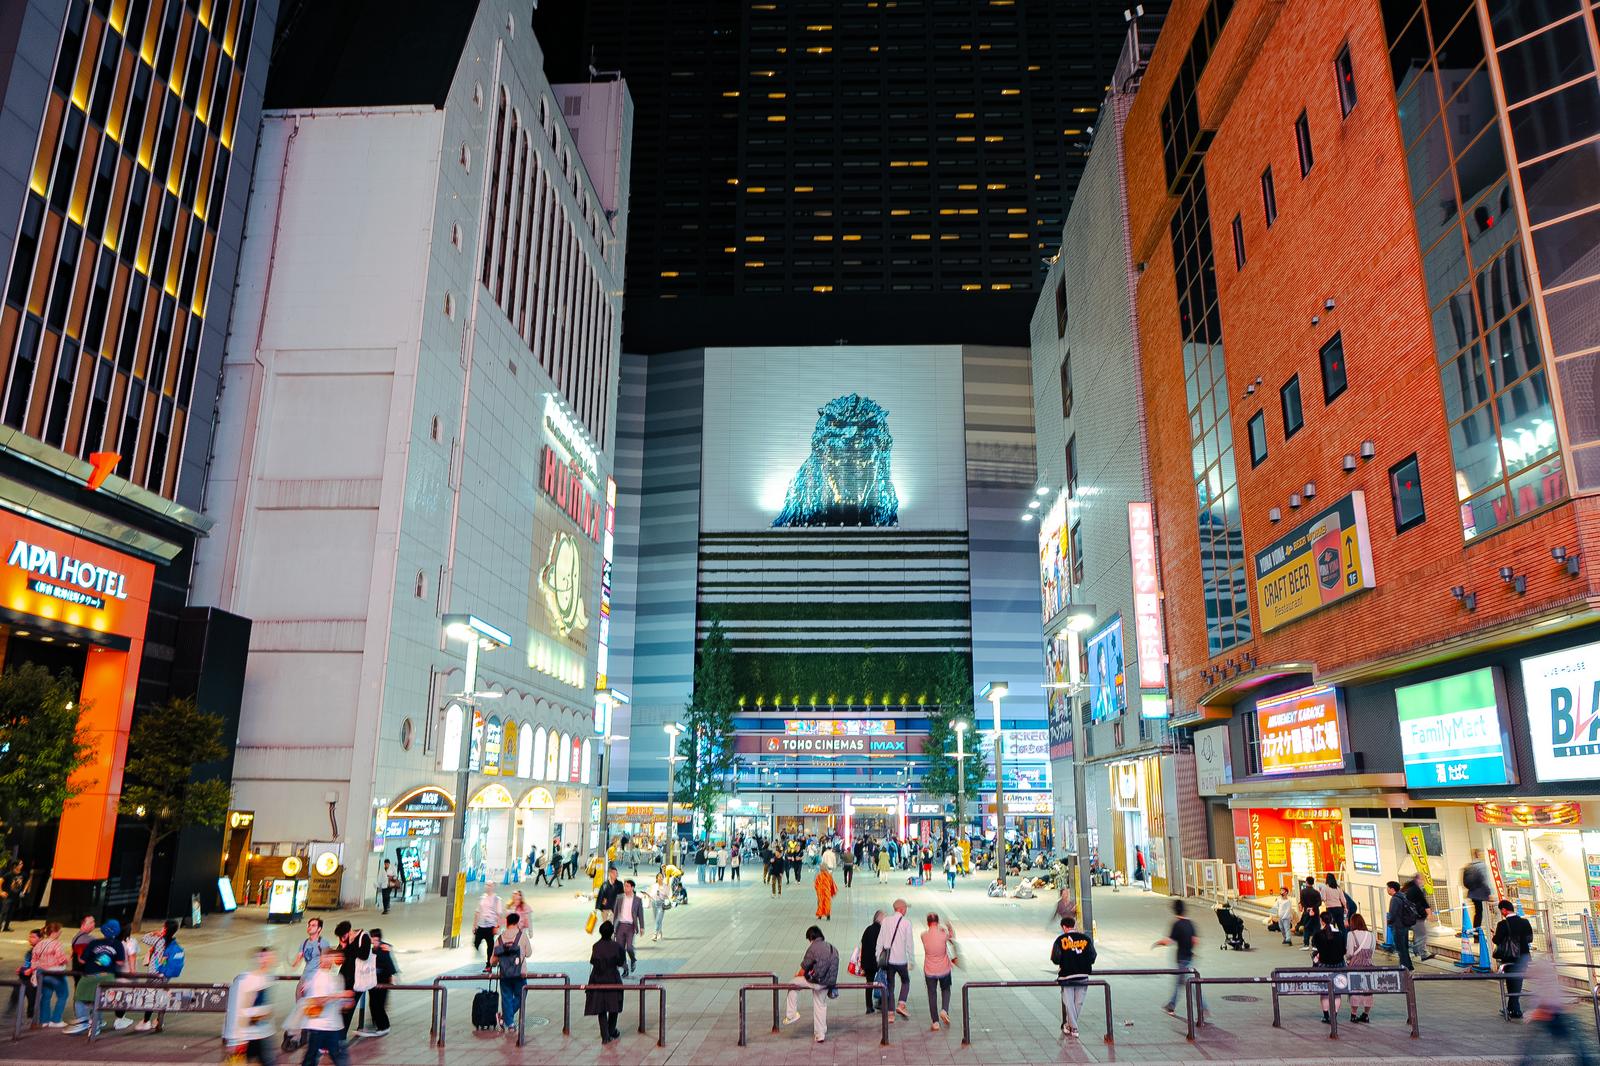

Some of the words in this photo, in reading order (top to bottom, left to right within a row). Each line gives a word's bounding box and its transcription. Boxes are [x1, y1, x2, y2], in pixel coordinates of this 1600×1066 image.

[544, 445, 601, 545] HUMAX
[7, 540, 58, 578] APA
[60, 556, 128, 600] HOTEL
[1348, 573, 1357, 585] 1F
[1263, 574, 1288, 607] CRAFT
[1288, 563, 1311, 595] BEER
[1298, 704, 1325, 722] KARAOKE
[1411, 714, 1487, 748] FamilyMart
[782, 739, 813, 751] TOHO
[815, 739, 864, 751] CINEMAS
[870, 741, 906, 751] IMAX
[920, 804, 939, 813] KFC
